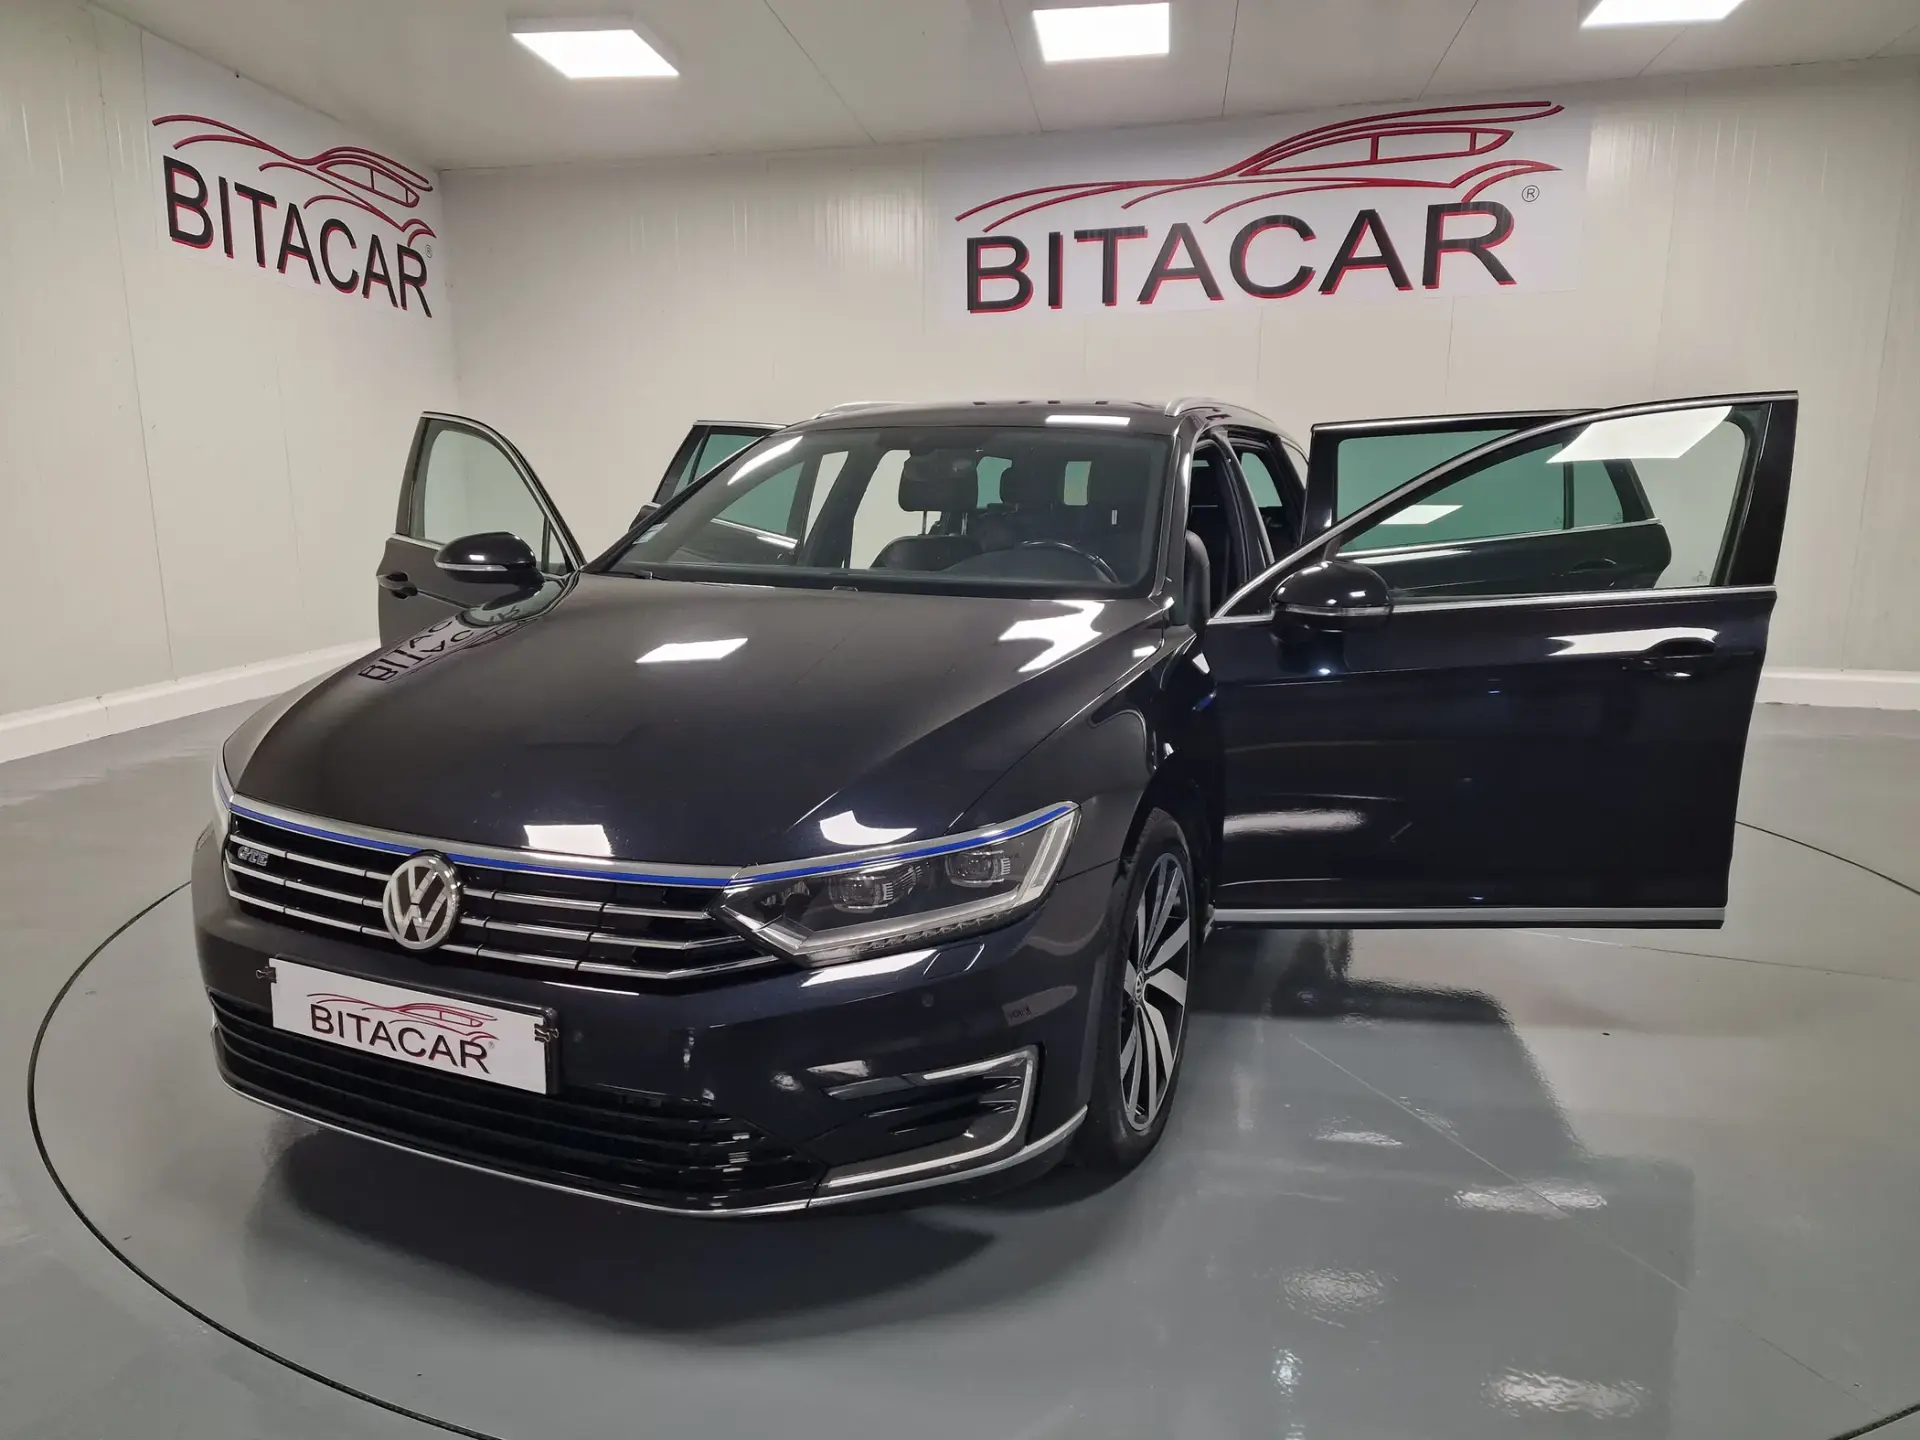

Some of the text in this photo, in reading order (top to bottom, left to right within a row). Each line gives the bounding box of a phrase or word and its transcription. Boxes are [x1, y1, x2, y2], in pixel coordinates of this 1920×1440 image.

[163, 155, 432, 318] BITACAR
[966, 200, 1517, 314] BITACAR
[386, 859, 454, 947] VW
[310, 1003, 491, 1075] BITACAR
